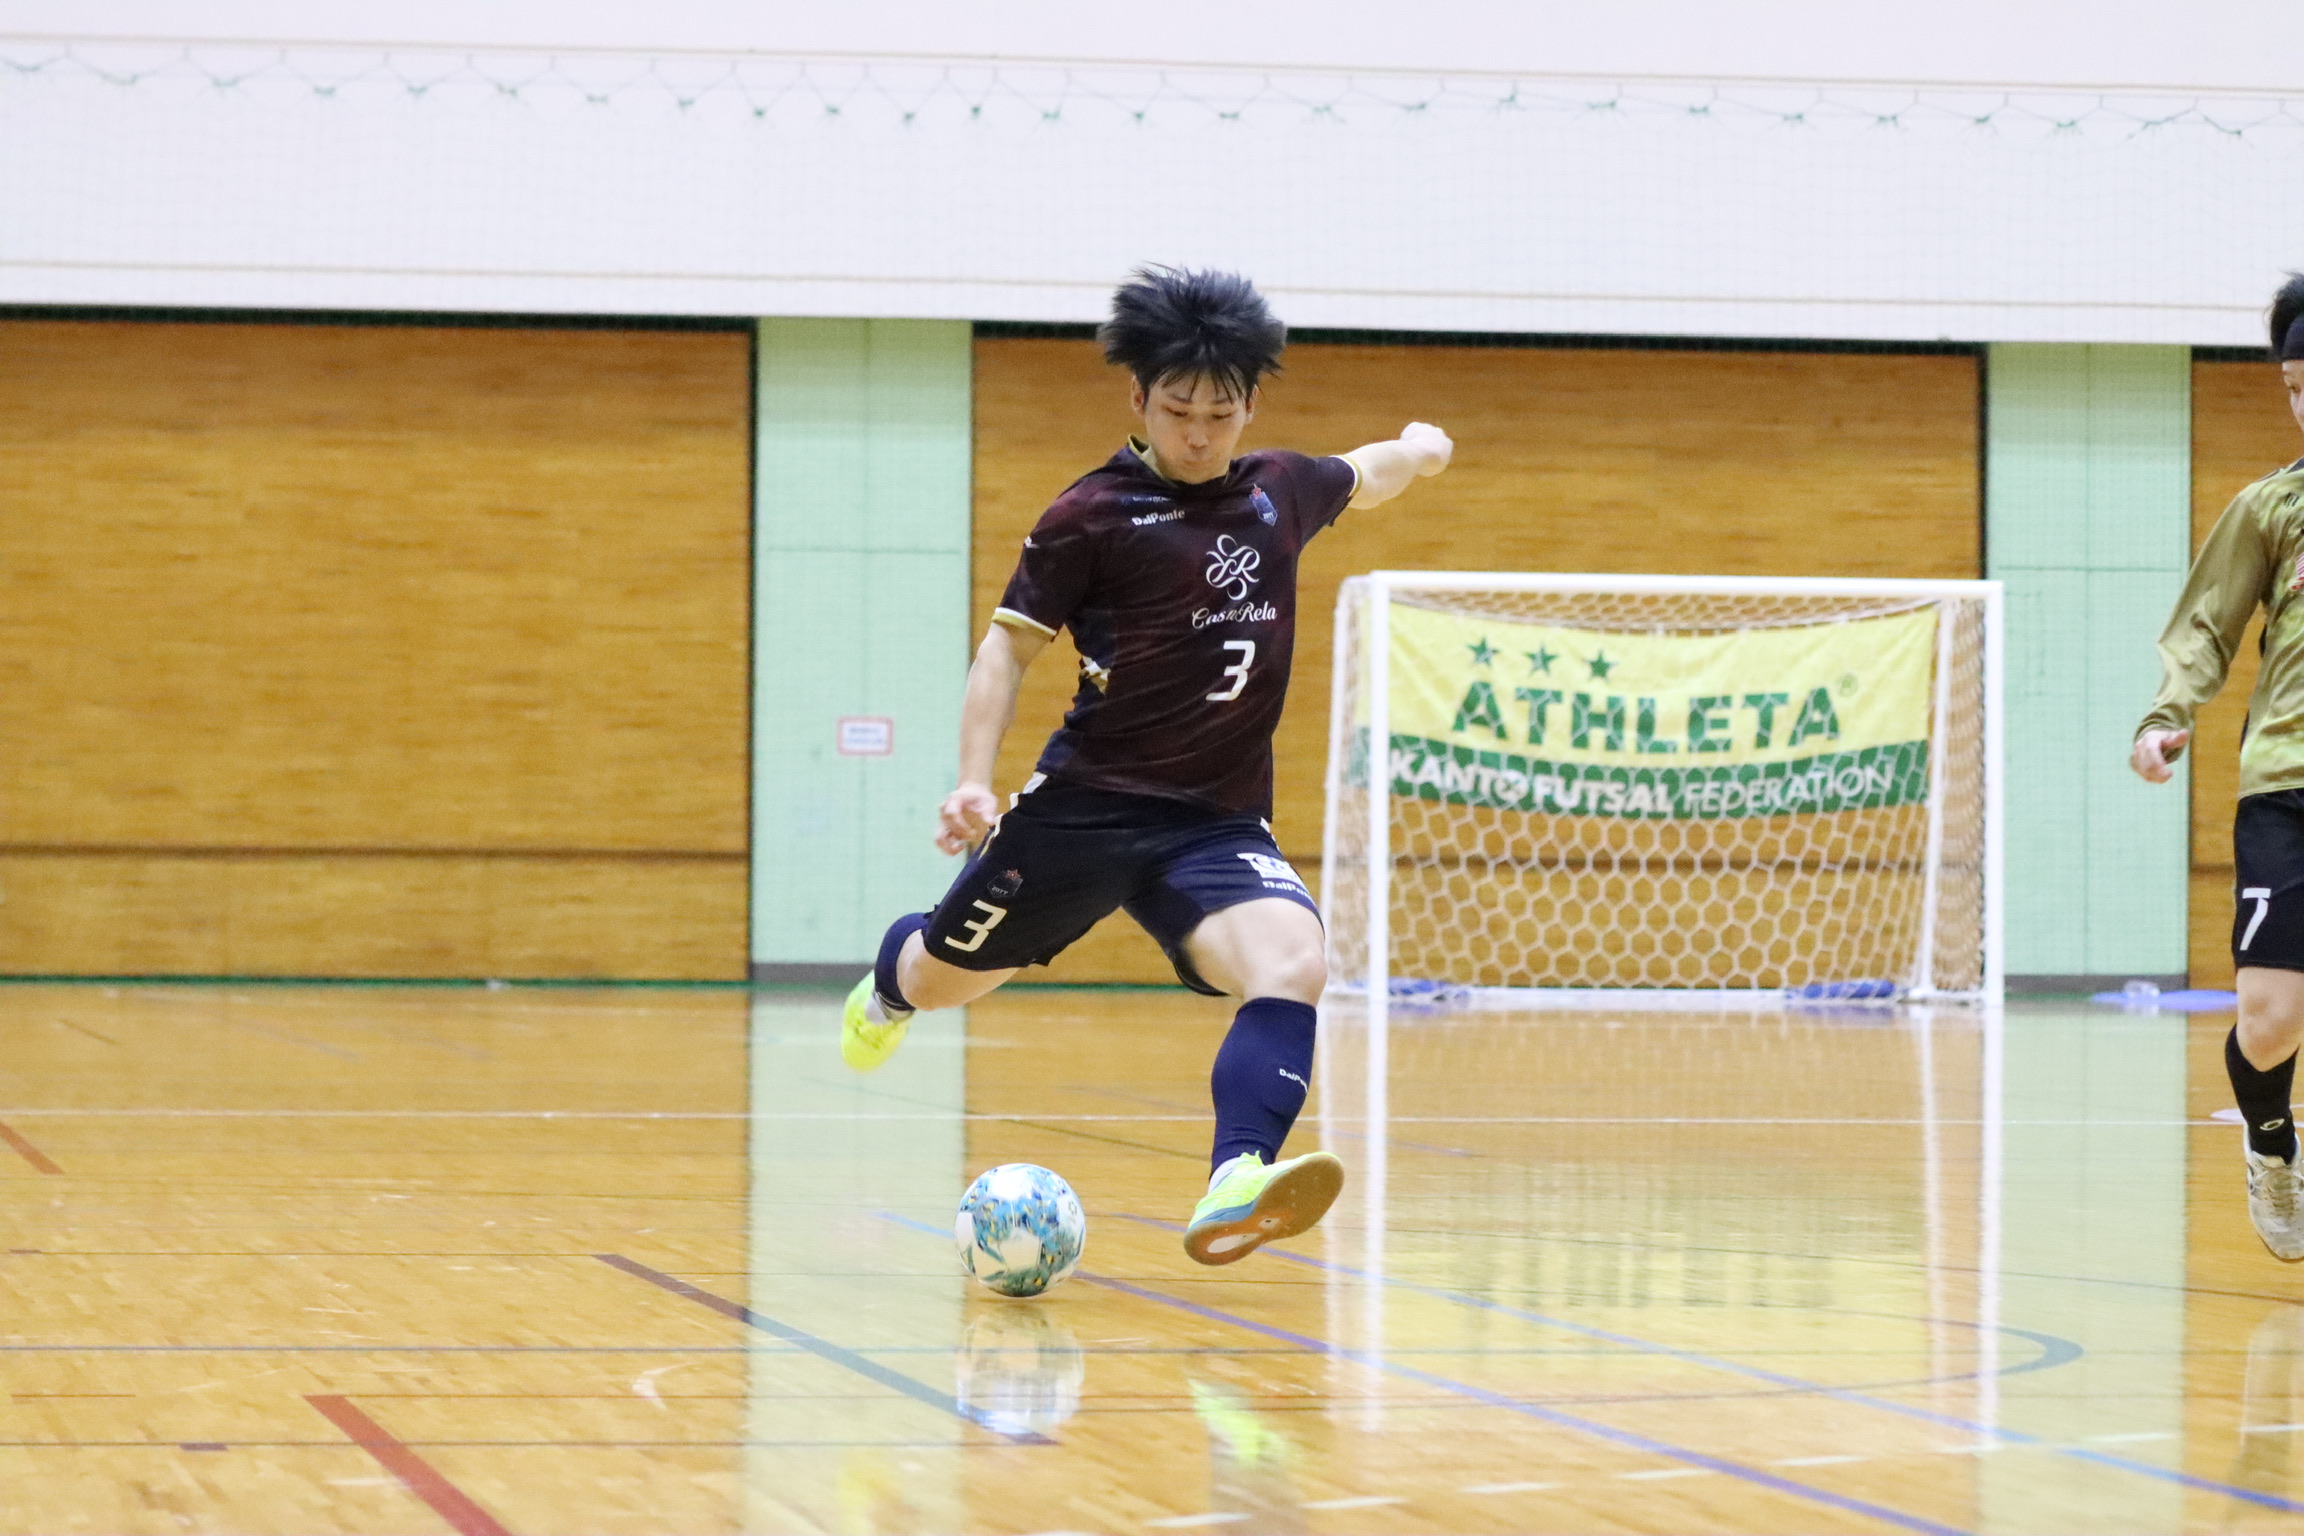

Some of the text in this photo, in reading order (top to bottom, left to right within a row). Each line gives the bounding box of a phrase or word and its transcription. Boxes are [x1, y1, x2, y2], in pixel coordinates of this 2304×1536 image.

[1131, 509, 1186, 526] DalPonte
[1205, 640, 1256, 702] 3
[1451, 681, 1840, 754] ATHLETA
[1389, 749, 1892, 813] KANTO FUTSAL FEDERATION
[944, 899, 1008, 952] 3
[2239, 887, 2271, 951] 7
